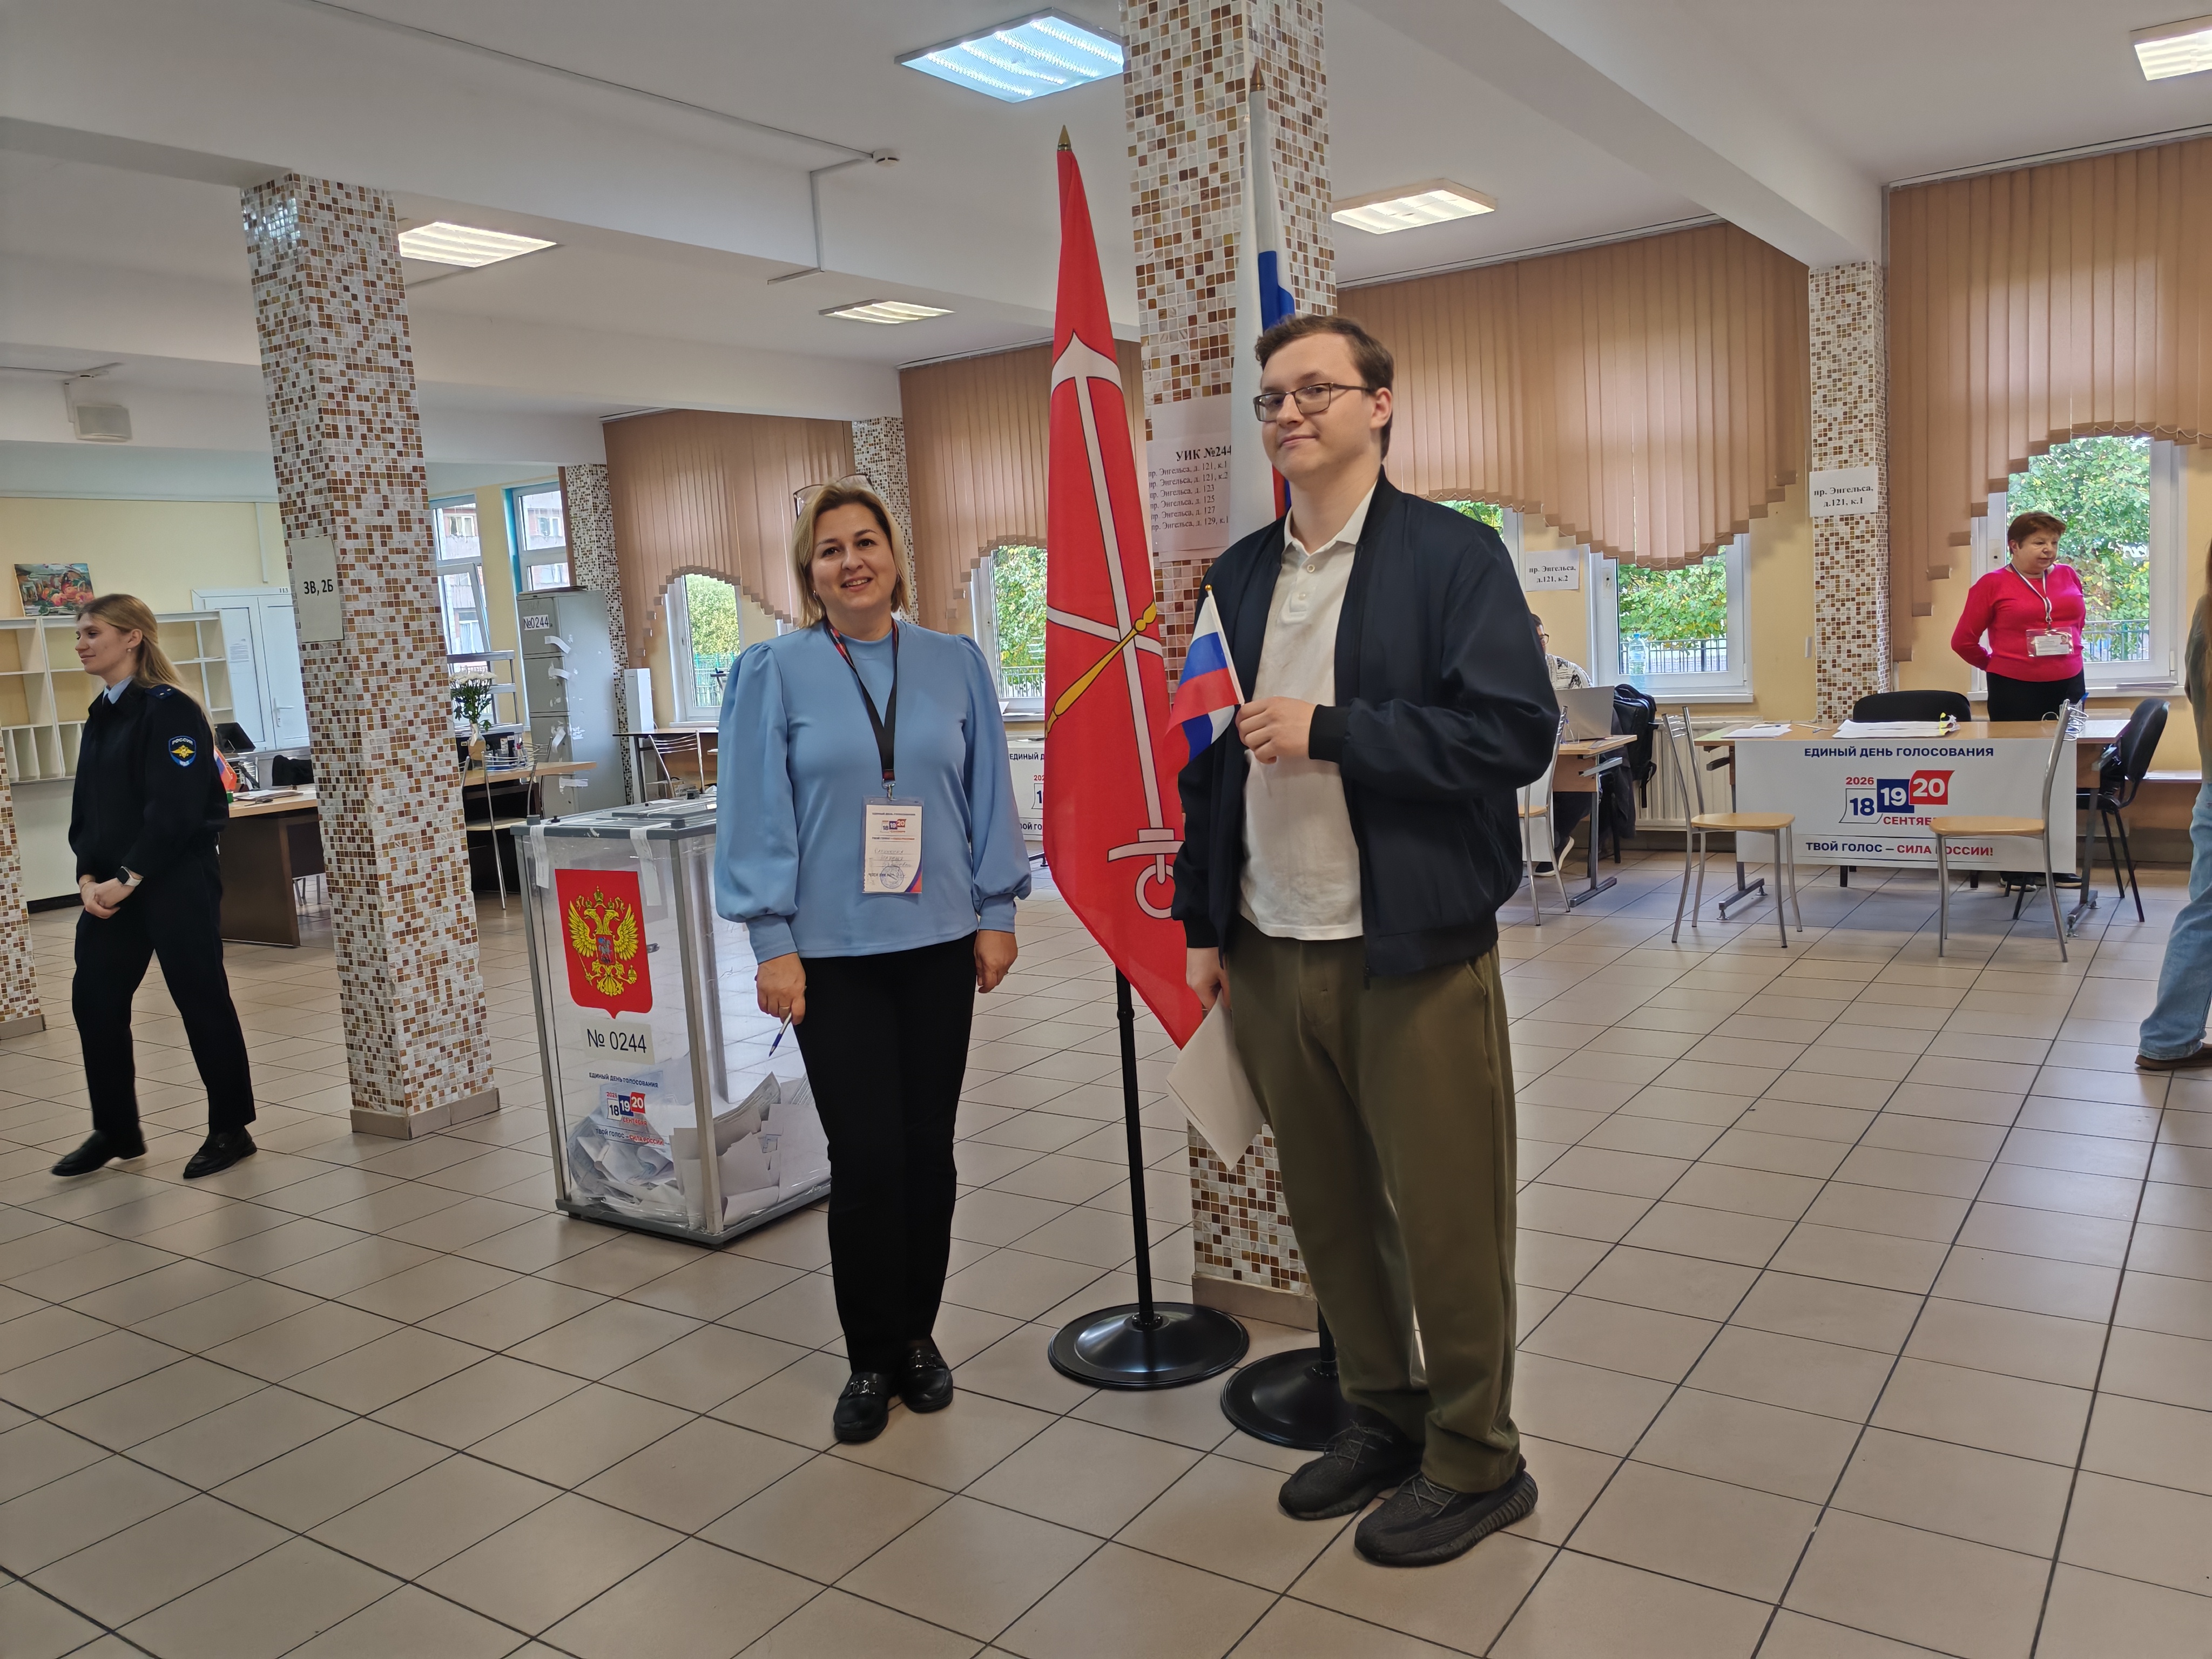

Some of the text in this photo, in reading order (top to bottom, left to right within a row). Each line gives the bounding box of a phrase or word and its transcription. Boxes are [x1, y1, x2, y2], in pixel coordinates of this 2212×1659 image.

[1176, 445, 1231, 461] УИК №244
[1160, 477, 1192, 486] Энгельса,
[1203, 473, 1216, 481] 121,
[1830, 486, 1873, 494] Энгельса,
[1204, 495, 1215, 503] 125
[1823, 499, 1848, 507] д.121,
[1205, 517, 1217, 525] 129,
[321, 579, 333, 592] 2Б
[523, 616, 549, 629] №0244
[1009, 752, 1038, 760] ЕДИНЫЙ
[1804, 746, 1994, 758] ЕДИНЫЙ ДЕНЬ ГОЛОСОВАНИЯ
[1846, 777, 1874, 785] 2026
[1037, 790, 1042, 804] 1
[1850, 778, 1945, 815] 18 19 20
[1883, 817, 1937, 825] СЕНТЯБ
[1806, 841, 1838, 852] ТВОЙ
[1842, 843, 1883, 853] ГОЛОС
[1897, 845, 1932, 854] СИЛА
[1936, 845, 1993, 856] ОССИИ!
[586, 1028, 647, 1053] № 0244
[589, 1072, 609, 1080] ЕДИНЫЙ
[623, 1078, 658, 1088] ГОЛОСОВАНИЯ
[609, 1096, 644, 1116] 18 19 20
[623, 1117, 648, 1126] СЕНТЯБРЯ
